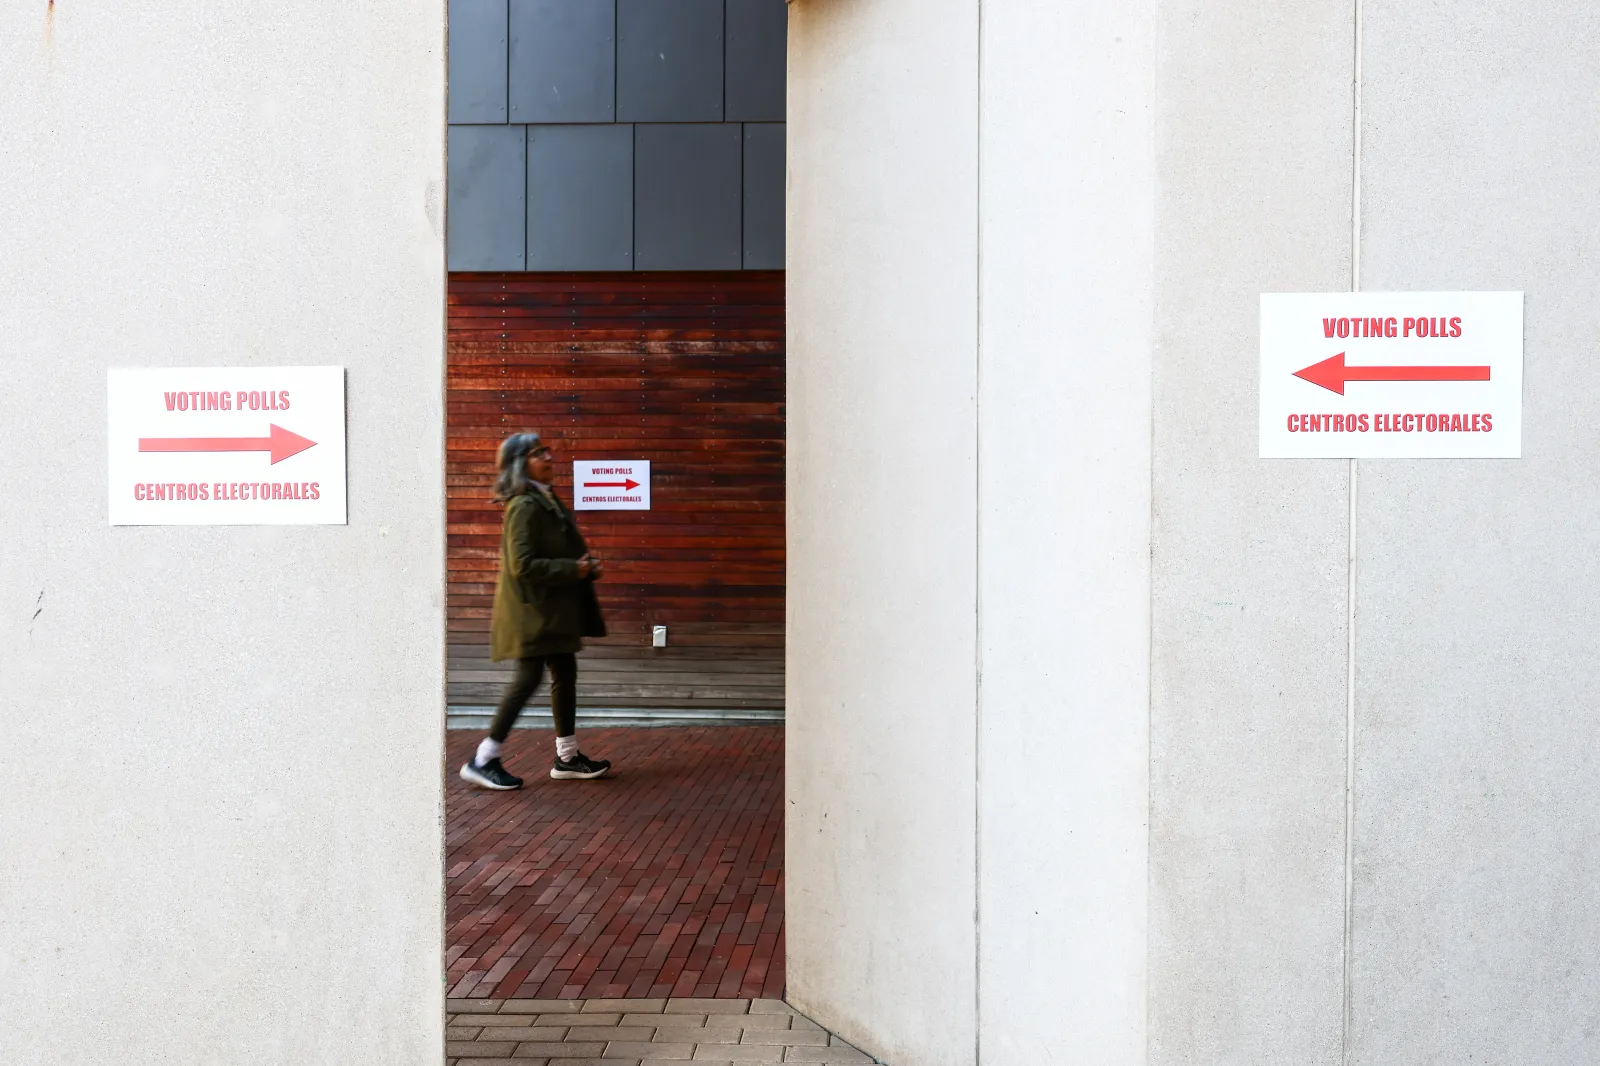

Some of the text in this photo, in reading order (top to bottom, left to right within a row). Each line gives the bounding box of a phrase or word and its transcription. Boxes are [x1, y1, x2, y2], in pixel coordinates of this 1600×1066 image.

[1322, 316, 1462, 338] VOTING POLLS
[164, 390, 290, 411] VOTING POLLS
[1287, 413, 1493, 432] CENTROS ELECTORALES
[134, 481, 320, 501] CENTROS ELECTORALES
